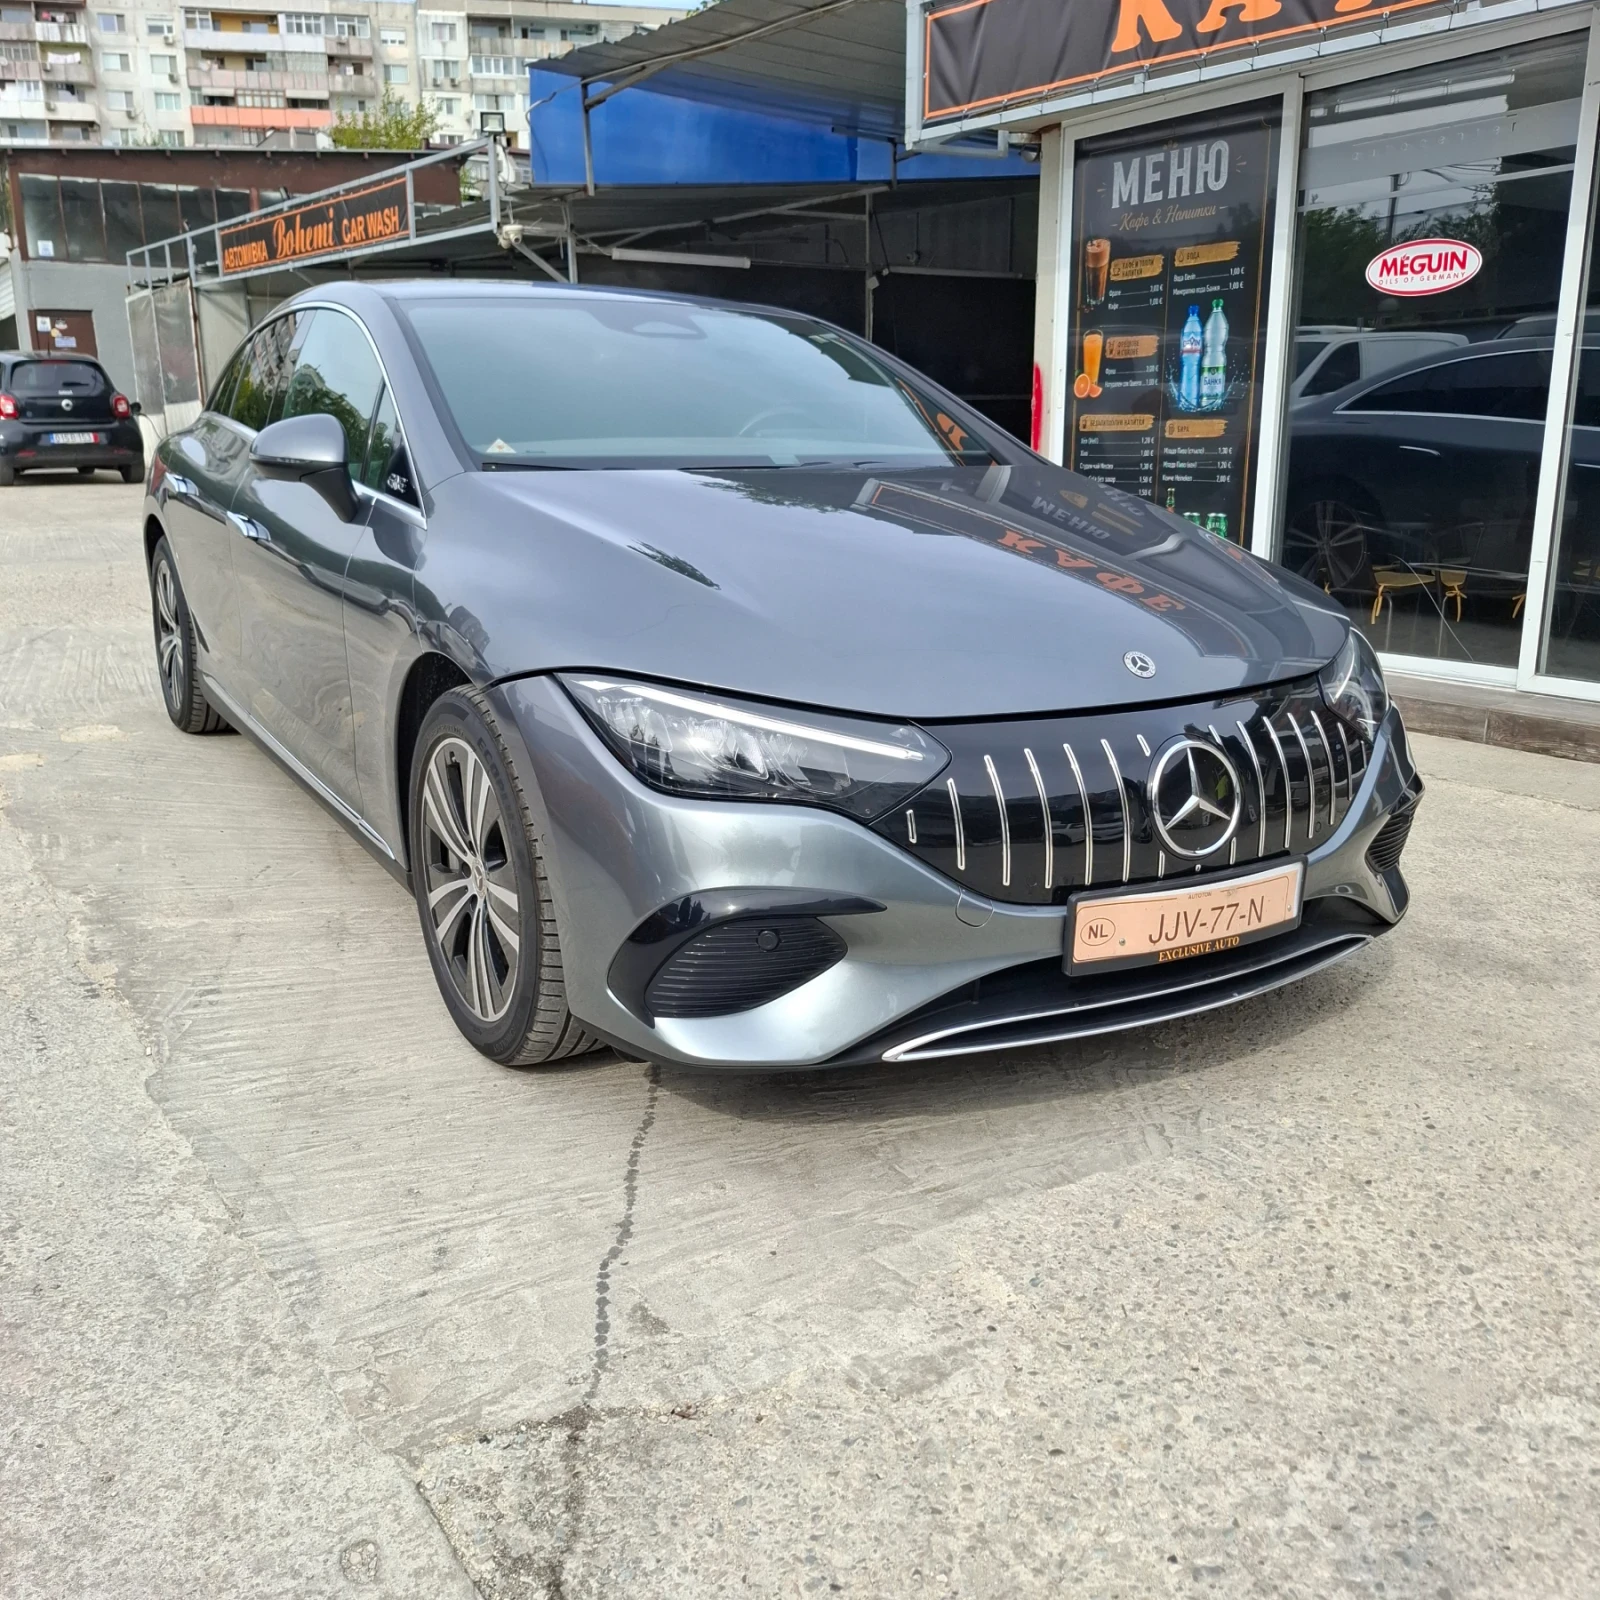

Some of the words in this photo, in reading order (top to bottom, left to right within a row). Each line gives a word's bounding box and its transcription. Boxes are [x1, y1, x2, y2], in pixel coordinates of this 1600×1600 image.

[1111, 140, 1230, 209] МЕНЮ
[1119, 213, 1149, 231] Кафе
[1152, 209, 1162, 225] &
[1165, 204, 1217, 224] Напитки
[224, 239, 269, 269] АВТОМИВКА
[273, 207, 335, 259] Bohemi
[341, 214, 366, 244] CAR
[366, 205, 399, 238] WASH
[1404, 276, 1414, 284] OF
[1420, 272, 1466, 282] GERMANY
[1087, 923, 1109, 940] NL
[1148, 896, 1264, 945] JJV-77-N
[1158, 943, 1213, 962] EXCLUSIVE
[1213, 936, 1240, 951] AUTO
